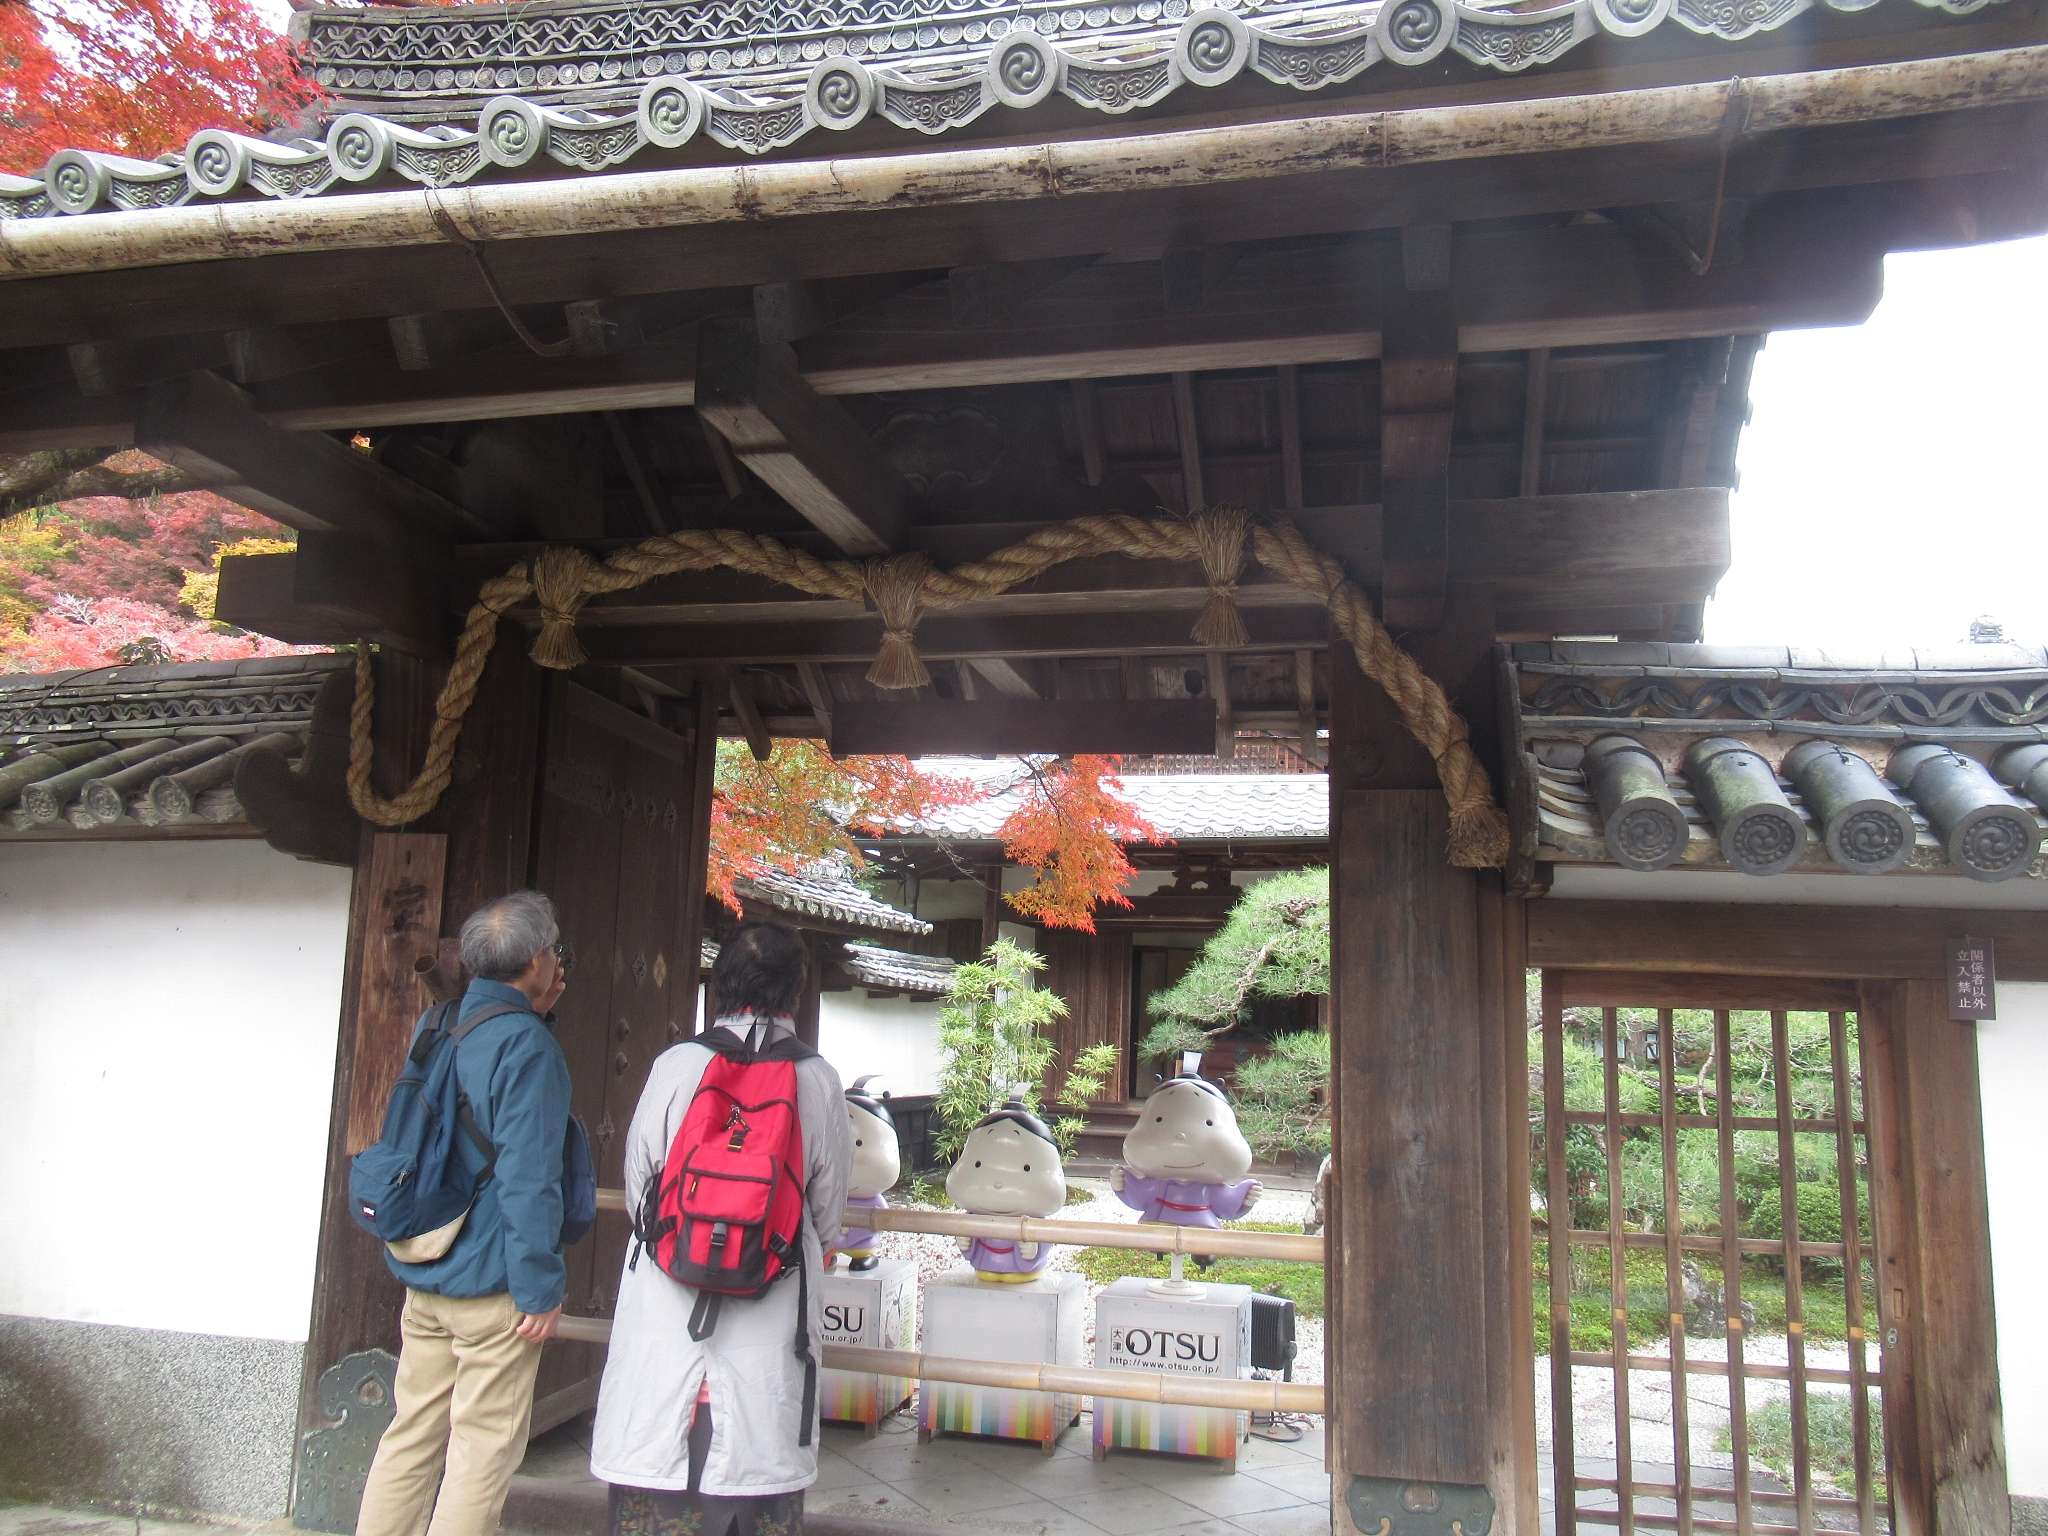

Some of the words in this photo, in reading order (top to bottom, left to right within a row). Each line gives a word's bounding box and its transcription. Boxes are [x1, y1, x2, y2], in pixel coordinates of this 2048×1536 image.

[1956, 949, 1972, 1008] 立入禁止
[1970, 949, 1986, 1010] 関係者以外
[822, 1305, 864, 1332] SU
[821, 1333, 863, 1344] tsu.or.jp/
[1112, 1328, 1122, 1352] 大津
[1125, 1328, 1220, 1362] OTSU
[1109, 1356, 1220, 1374] http://www.otsu.or.jp/
